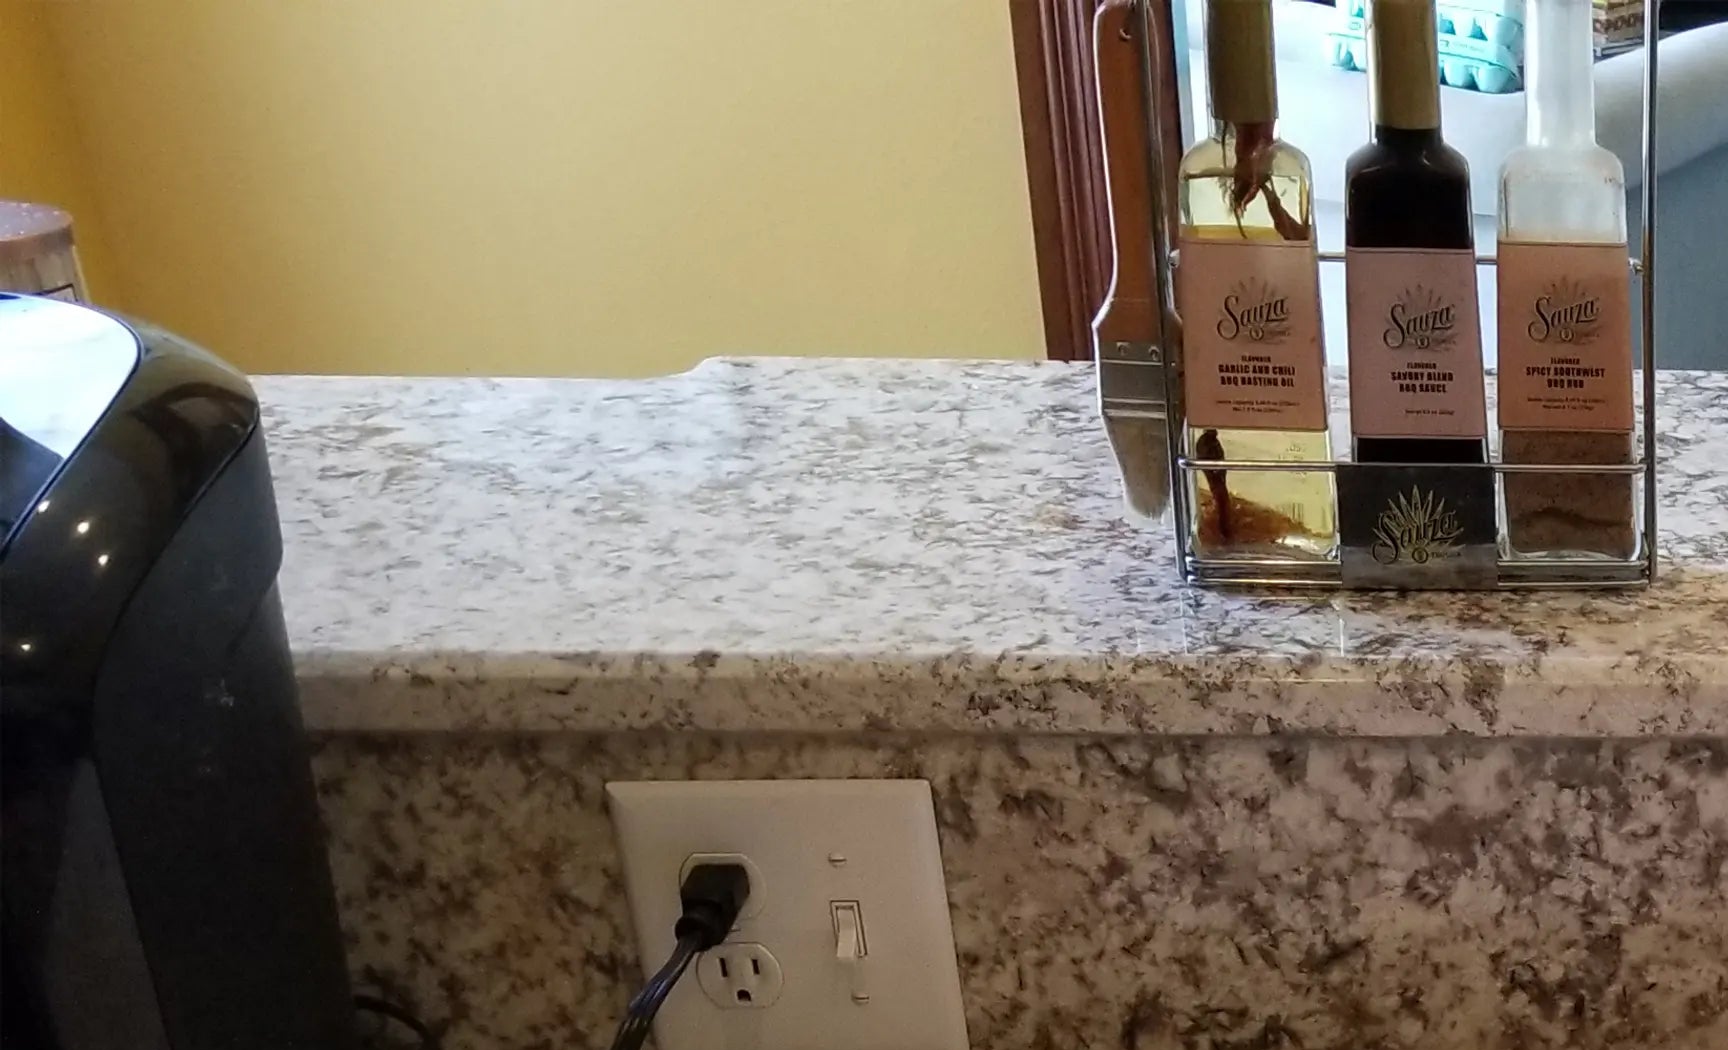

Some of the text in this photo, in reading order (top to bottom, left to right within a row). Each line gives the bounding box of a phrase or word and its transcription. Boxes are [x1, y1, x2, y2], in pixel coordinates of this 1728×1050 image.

[1217, 295, 1289, 340] Sauza
[1528, 297, 1599, 342] Sauza
[1383, 304, 1455, 349] Sauza
[1218, 364, 1249, 373] GARLIC
[1252, 365, 1270, 374] AND
[1526, 366, 1605, 378] SPICY SOUTHWEST
[1241, 376, 1279, 387] BASTING
[1281, 377, 1294, 387] OIL
[1391, 372, 1454, 381] SAVORY BLEND
[1419, 383, 1447, 393] SAUCE
